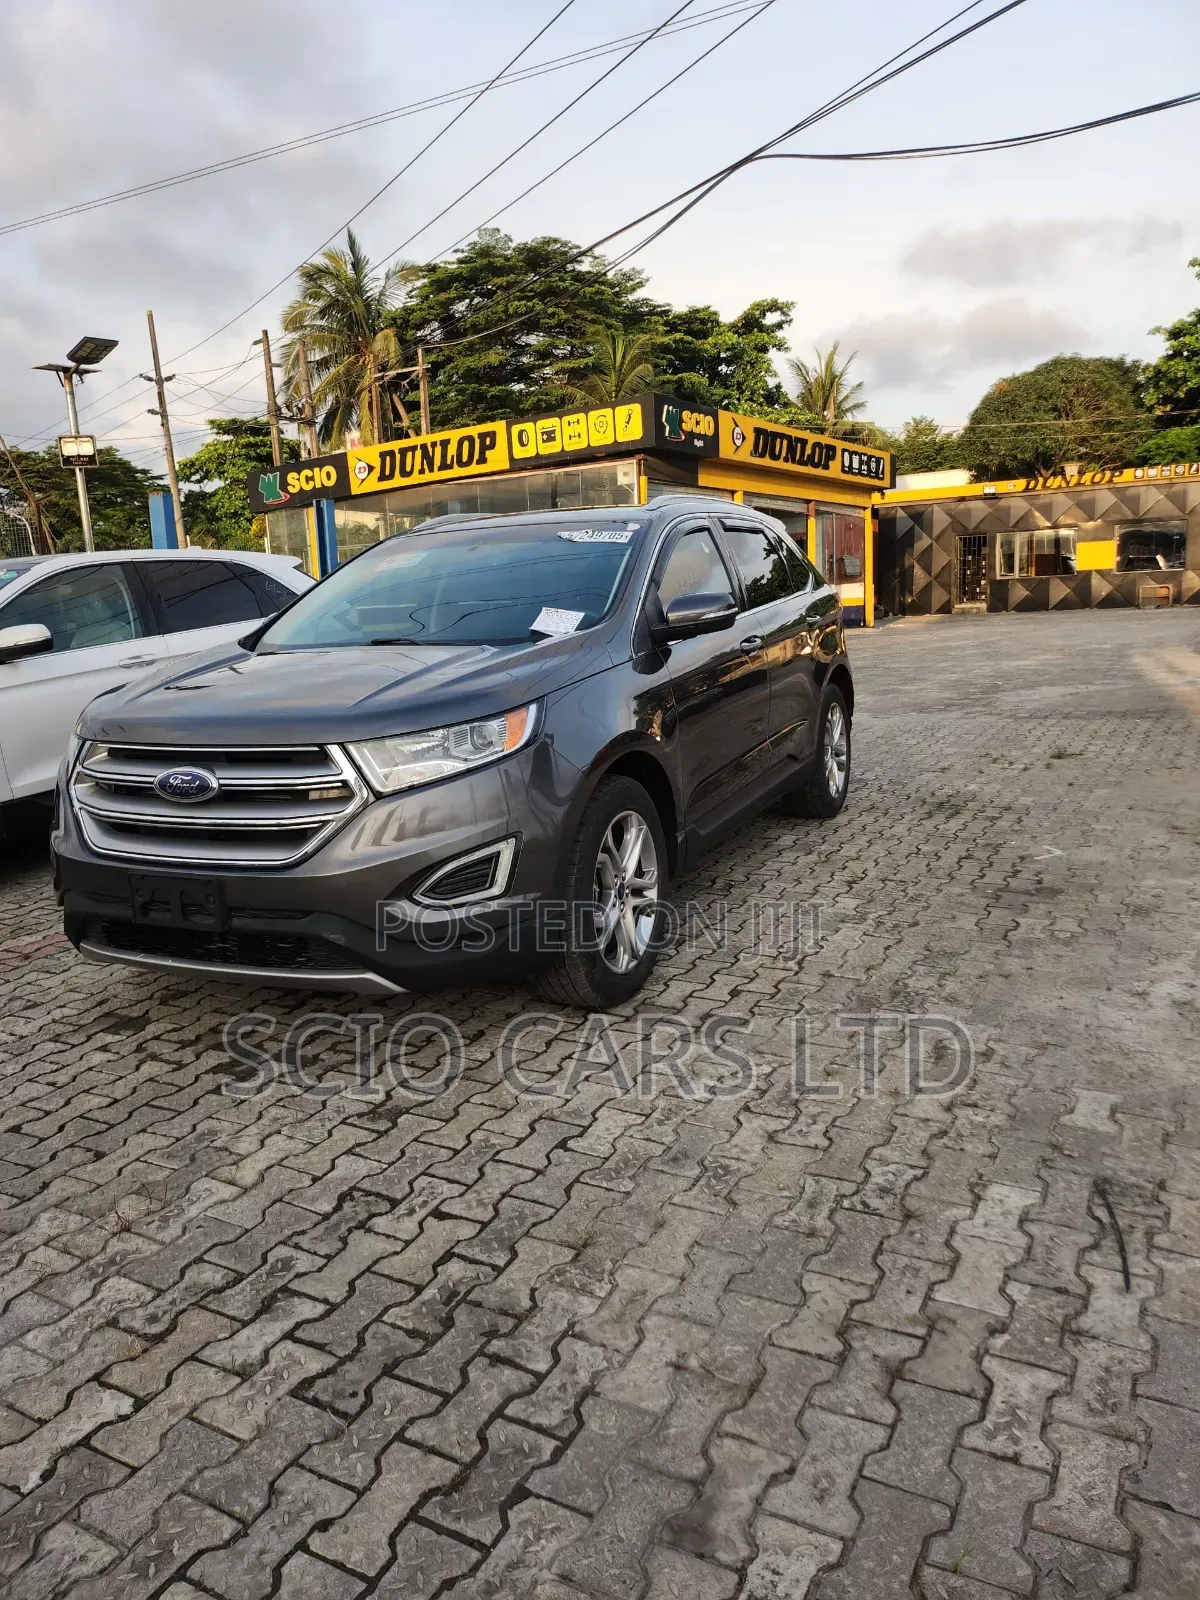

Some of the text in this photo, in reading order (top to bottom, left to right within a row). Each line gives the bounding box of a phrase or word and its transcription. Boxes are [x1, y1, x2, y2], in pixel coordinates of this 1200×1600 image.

[682, 410, 715, 436] SCIO
[377, 430, 497, 483] DUNLOP
[750, 426, 837, 470] DUNLOP
[286, 465, 337, 494] SCIO
[1022, 470, 1124, 491] DUNLOP
[166, 774, 200, 794] Ford
